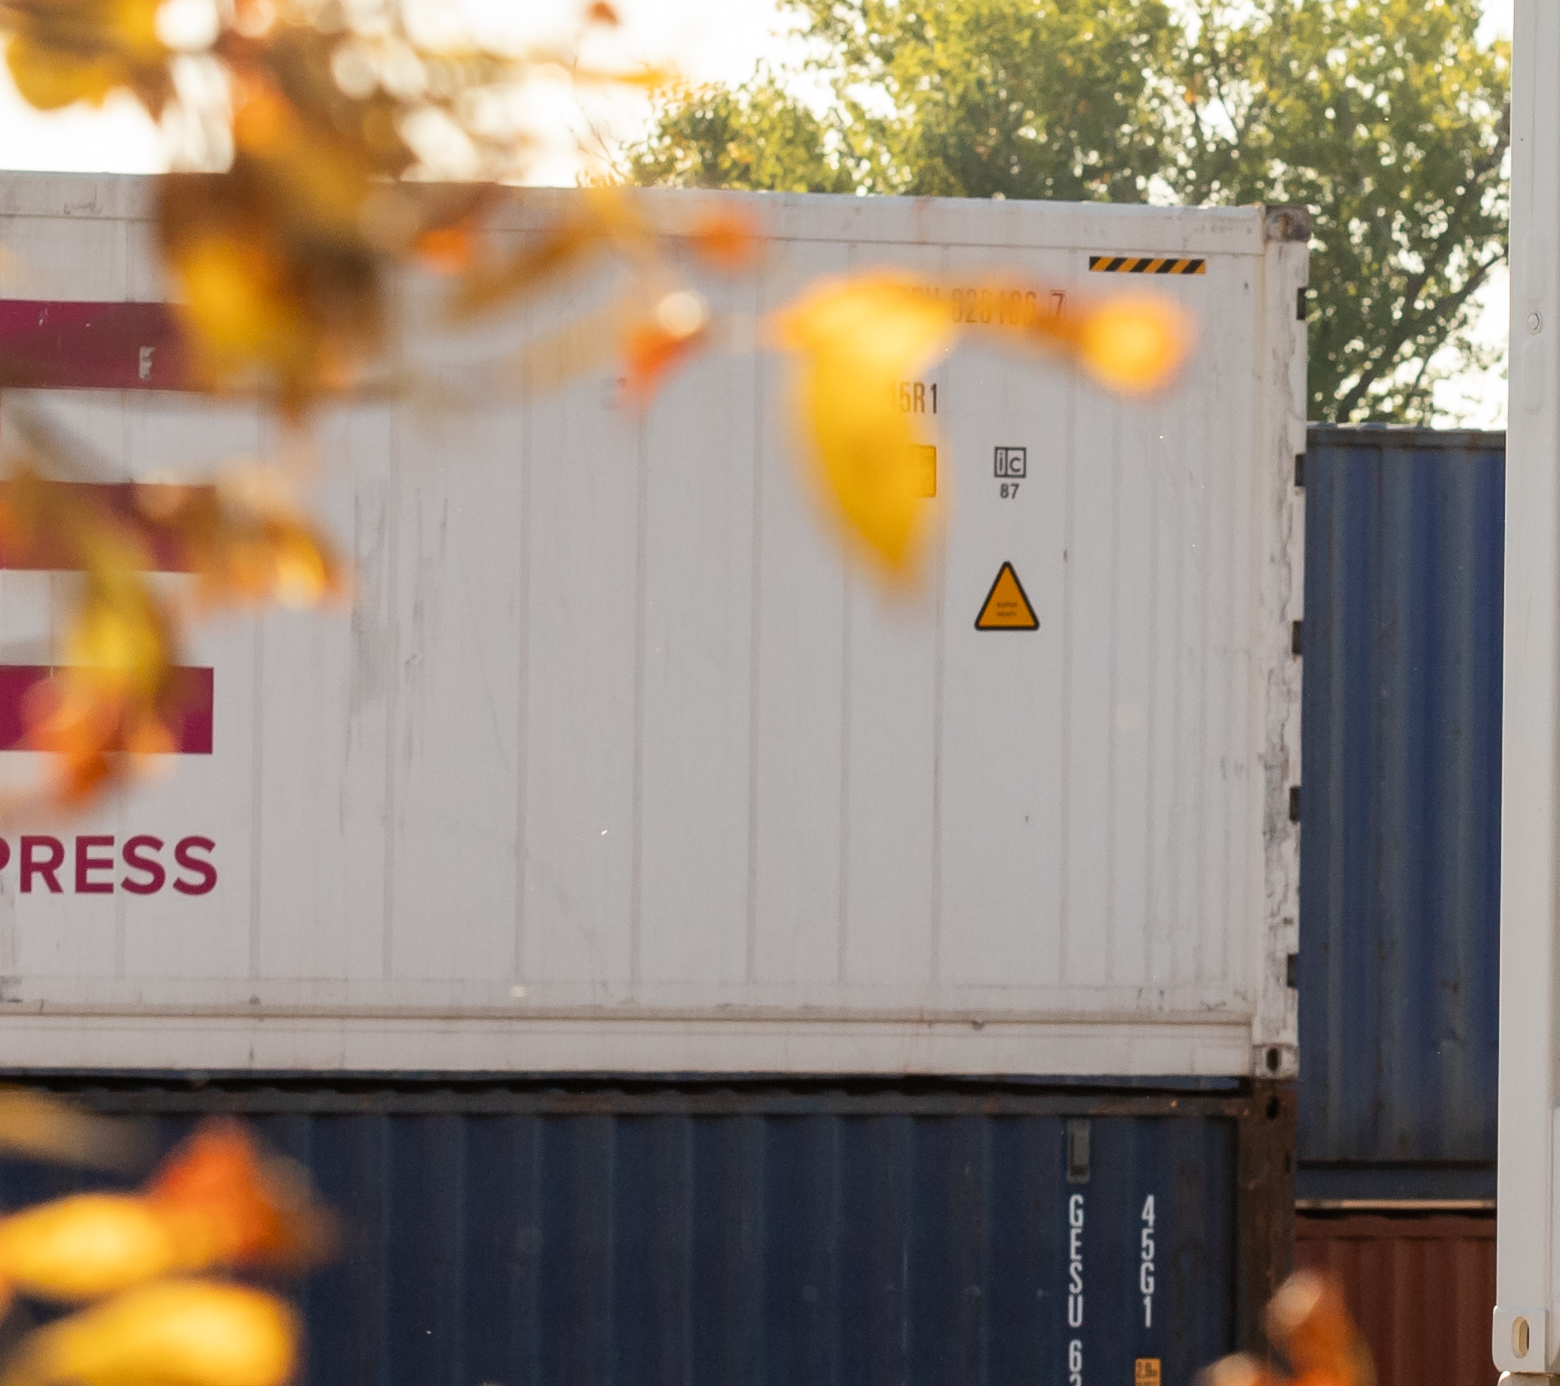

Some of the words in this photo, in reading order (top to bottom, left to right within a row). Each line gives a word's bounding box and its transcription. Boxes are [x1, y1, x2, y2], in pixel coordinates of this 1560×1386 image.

[999, 483, 1020, 500] 87
[1068, 1194, 1085, 1327] GESU
[1141, 1194, 1155, 1327] 45G1
